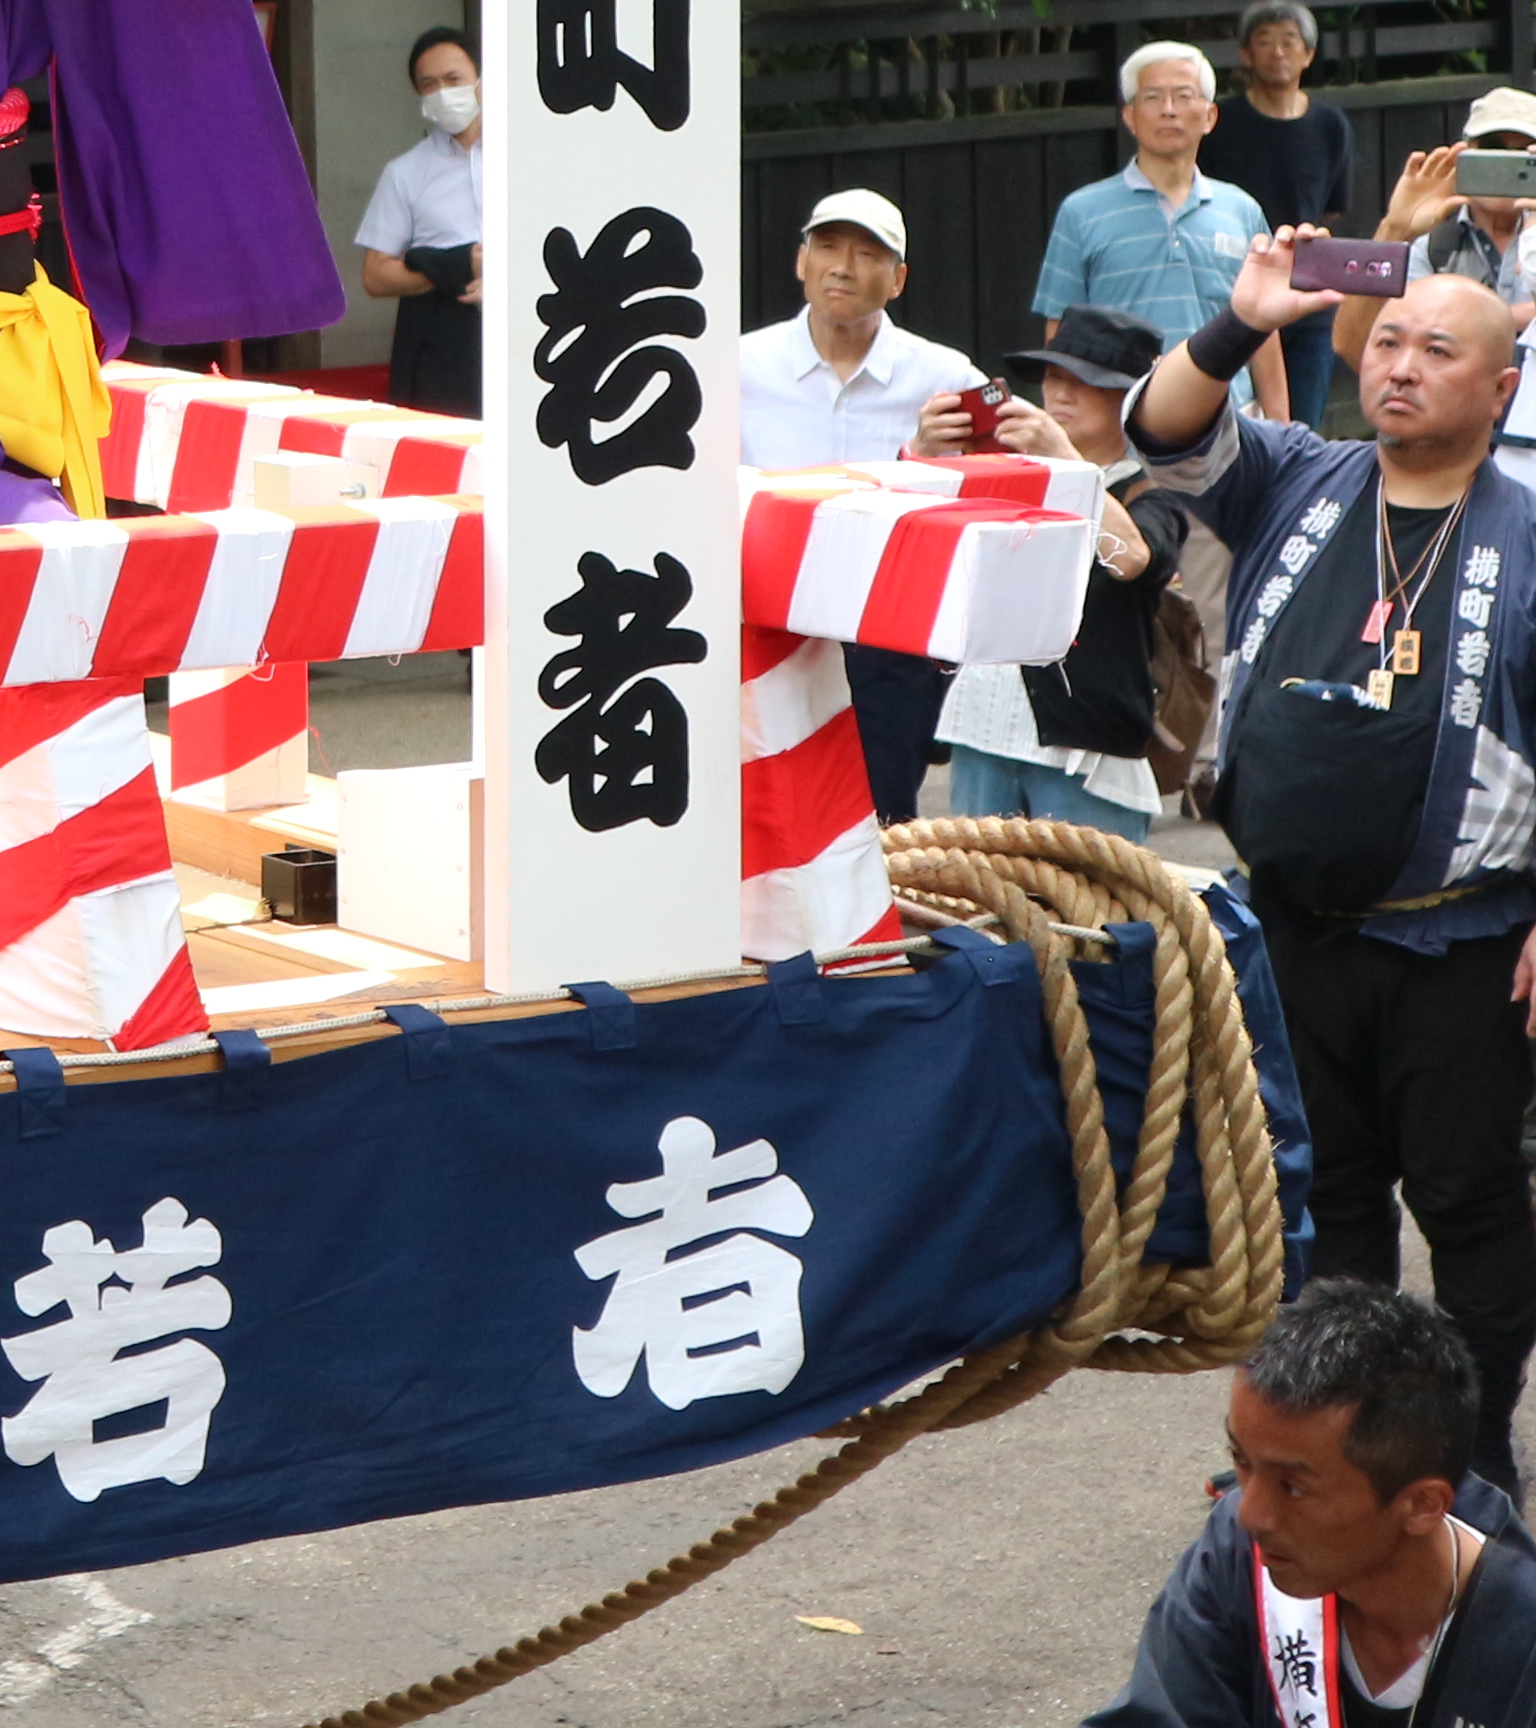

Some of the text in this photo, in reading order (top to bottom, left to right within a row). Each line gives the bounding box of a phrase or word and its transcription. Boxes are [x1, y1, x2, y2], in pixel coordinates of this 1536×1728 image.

[1240, 497, 1342, 664] 横町若者
[1450, 545, 1501, 729] 横町若者
